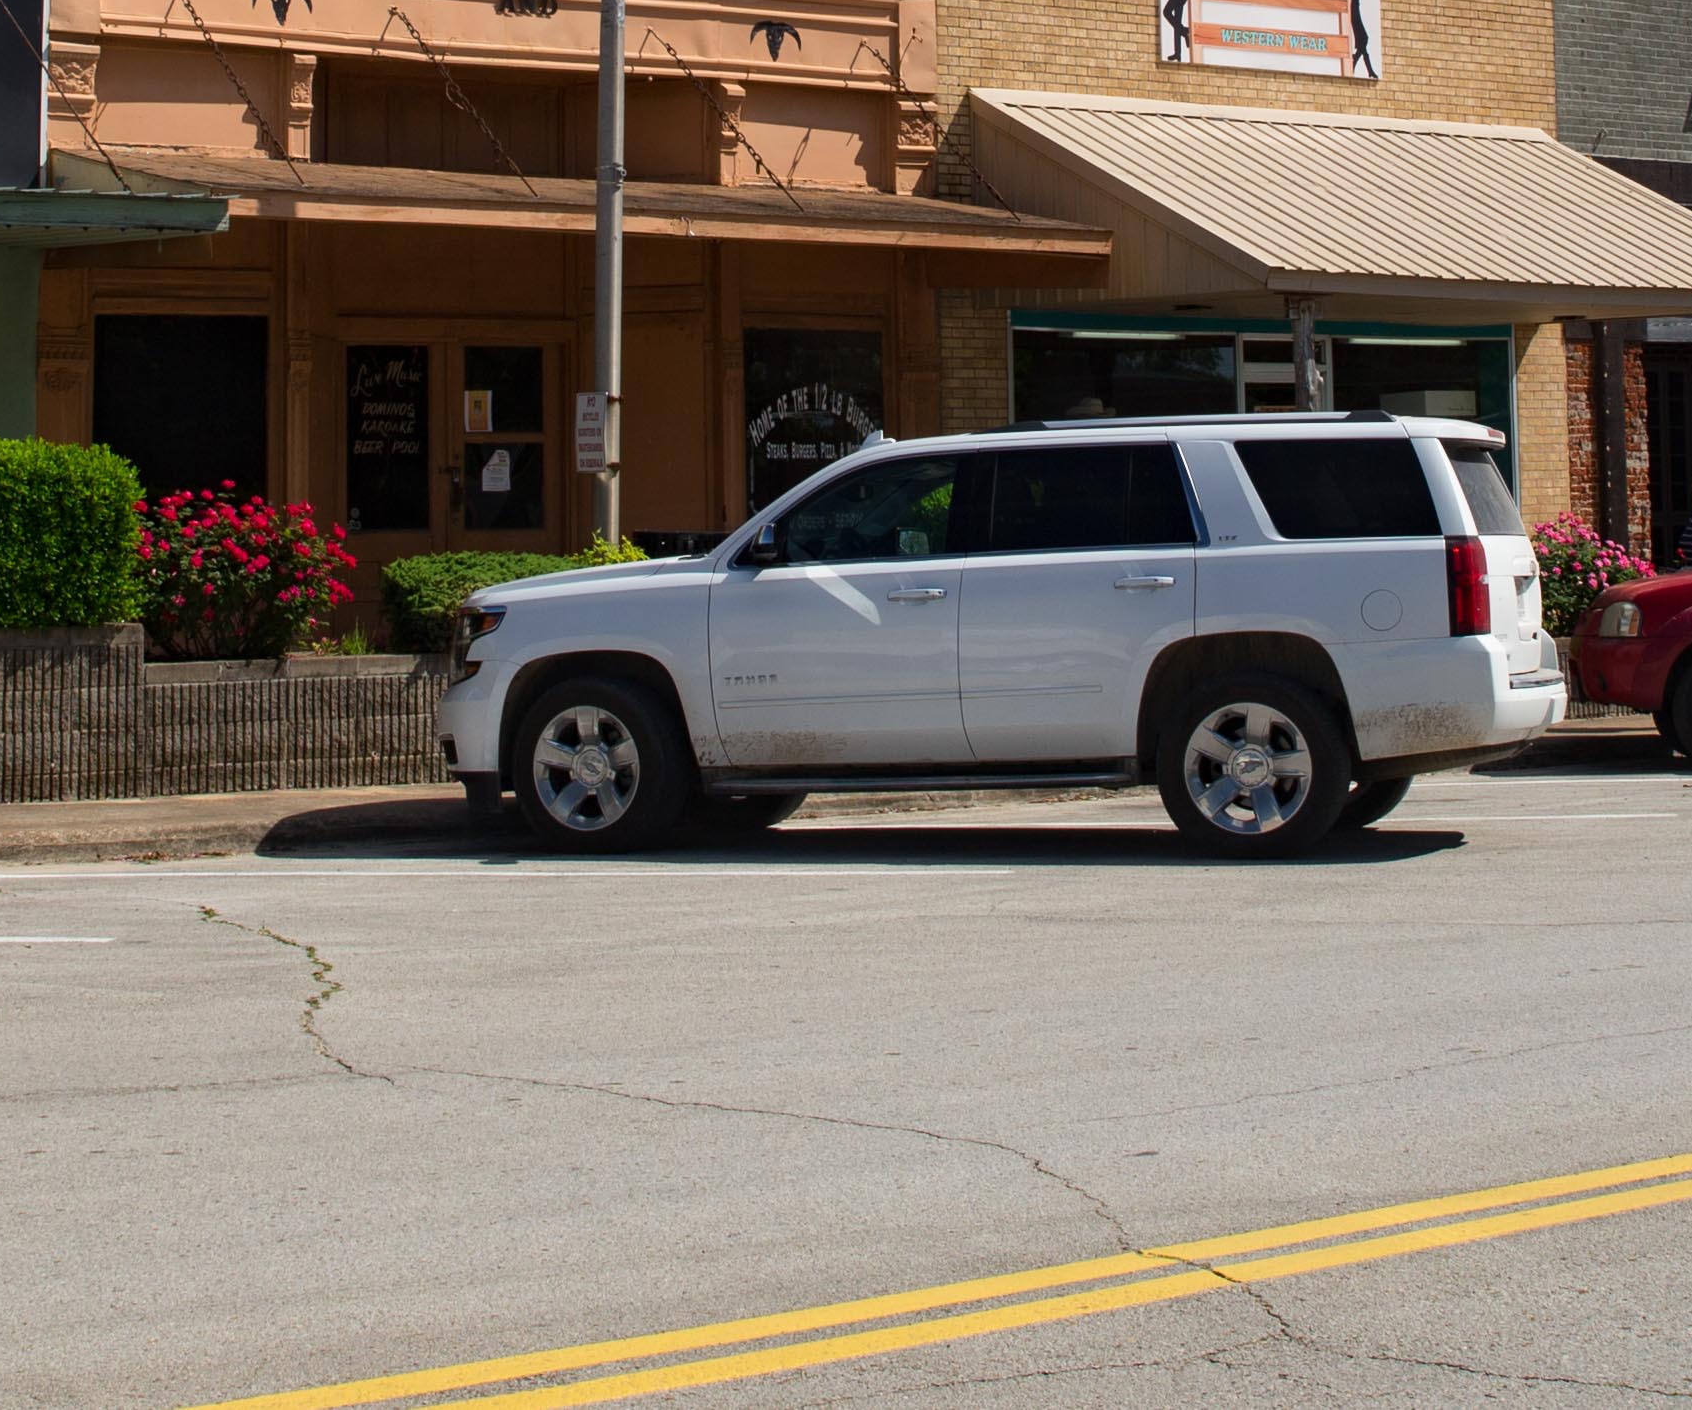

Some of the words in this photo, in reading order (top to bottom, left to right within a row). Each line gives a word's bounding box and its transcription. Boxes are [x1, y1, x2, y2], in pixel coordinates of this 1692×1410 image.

[1220, 27, 1285, 47] WESTERN
[1288, 36, 1328, 52] WEAR
[362, 401, 416, 418] DOMINOS
[748, 406, 776, 447] HOME
[776, 393, 789, 420] OF
[791, 386, 809, 412] THE
[831, 390, 843, 417] LB
[353, 439, 384, 455] BEER
[391, 439, 420, 455] POOL
